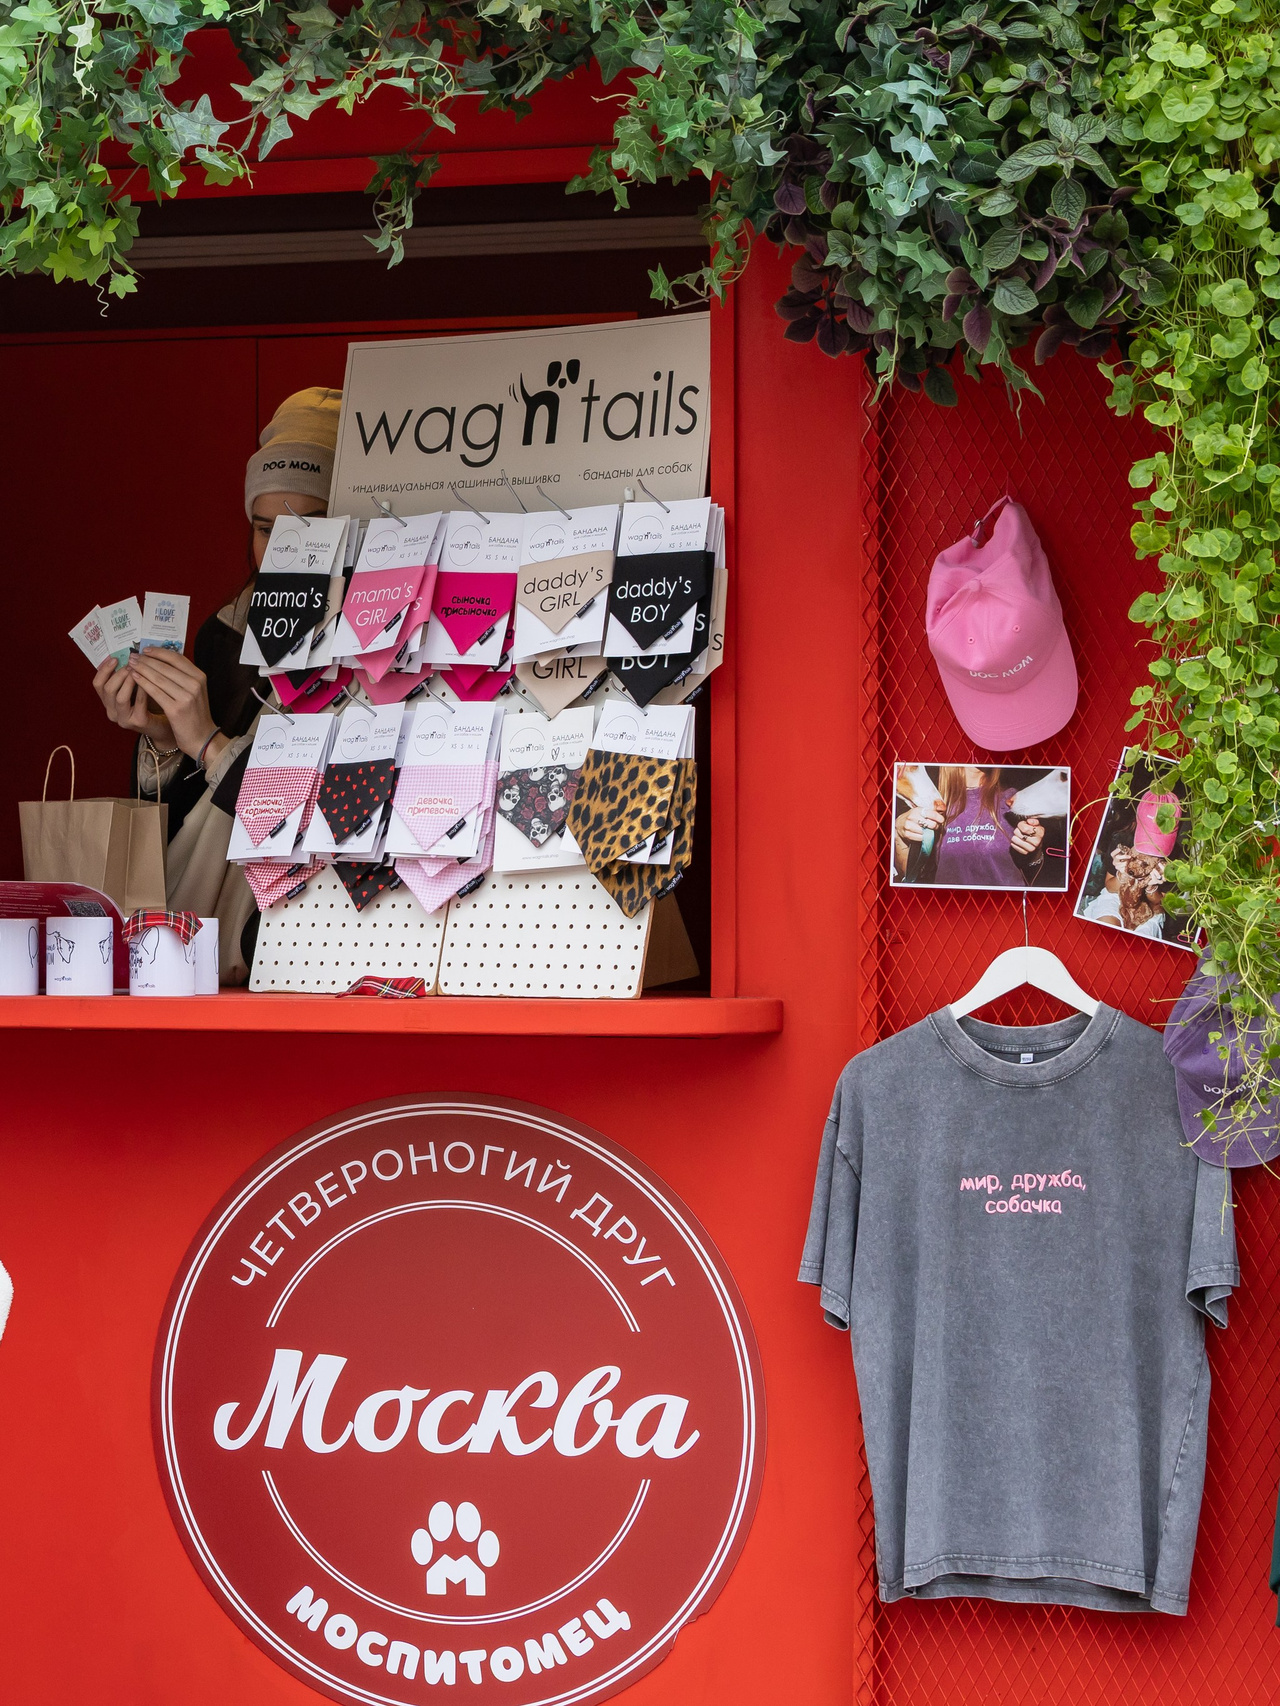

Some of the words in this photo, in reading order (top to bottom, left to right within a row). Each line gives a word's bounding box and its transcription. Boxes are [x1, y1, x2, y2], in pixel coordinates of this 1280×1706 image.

[262, 460, 286, 472] DOG
[289, 460, 321, 474] MOM
[583, 467, 635, 481] банданы
[637, 465, 655, 478] для
[657, 461, 693, 474] собак
[352, 480, 445, 495] индивидуальная
[511, 473, 561, 486] вышивка
[451, 595, 491, 605] сыночка
[539, 591, 581, 613] GIRL
[355, 608, 388, 627] GIRL
[440, 606, 497, 618] присыночка
[630, 603, 671, 623] BOY
[261, 617, 300, 638] BOY
[532, 656, 588, 679] GIRL
[1002, 655, 1034, 678] MOM
[407, 806, 460, 816] припевочка
[416, 797, 453, 807] девочка
[962, 833, 995, 842] собачки
[959, 1172, 1003, 1192] мир,
[1010, 1169, 1087, 1192] дружба,
[985, 1195, 1062, 1215] собачка
[230, 1141, 574, 1289] ЧЕТВЕРОНОГИЙ
[569, 1192, 677, 1290] ДРУГ
[213, 1348, 700, 1459] Москва
[285, 1586, 632, 1686] МОСПИТОМЕЦ
